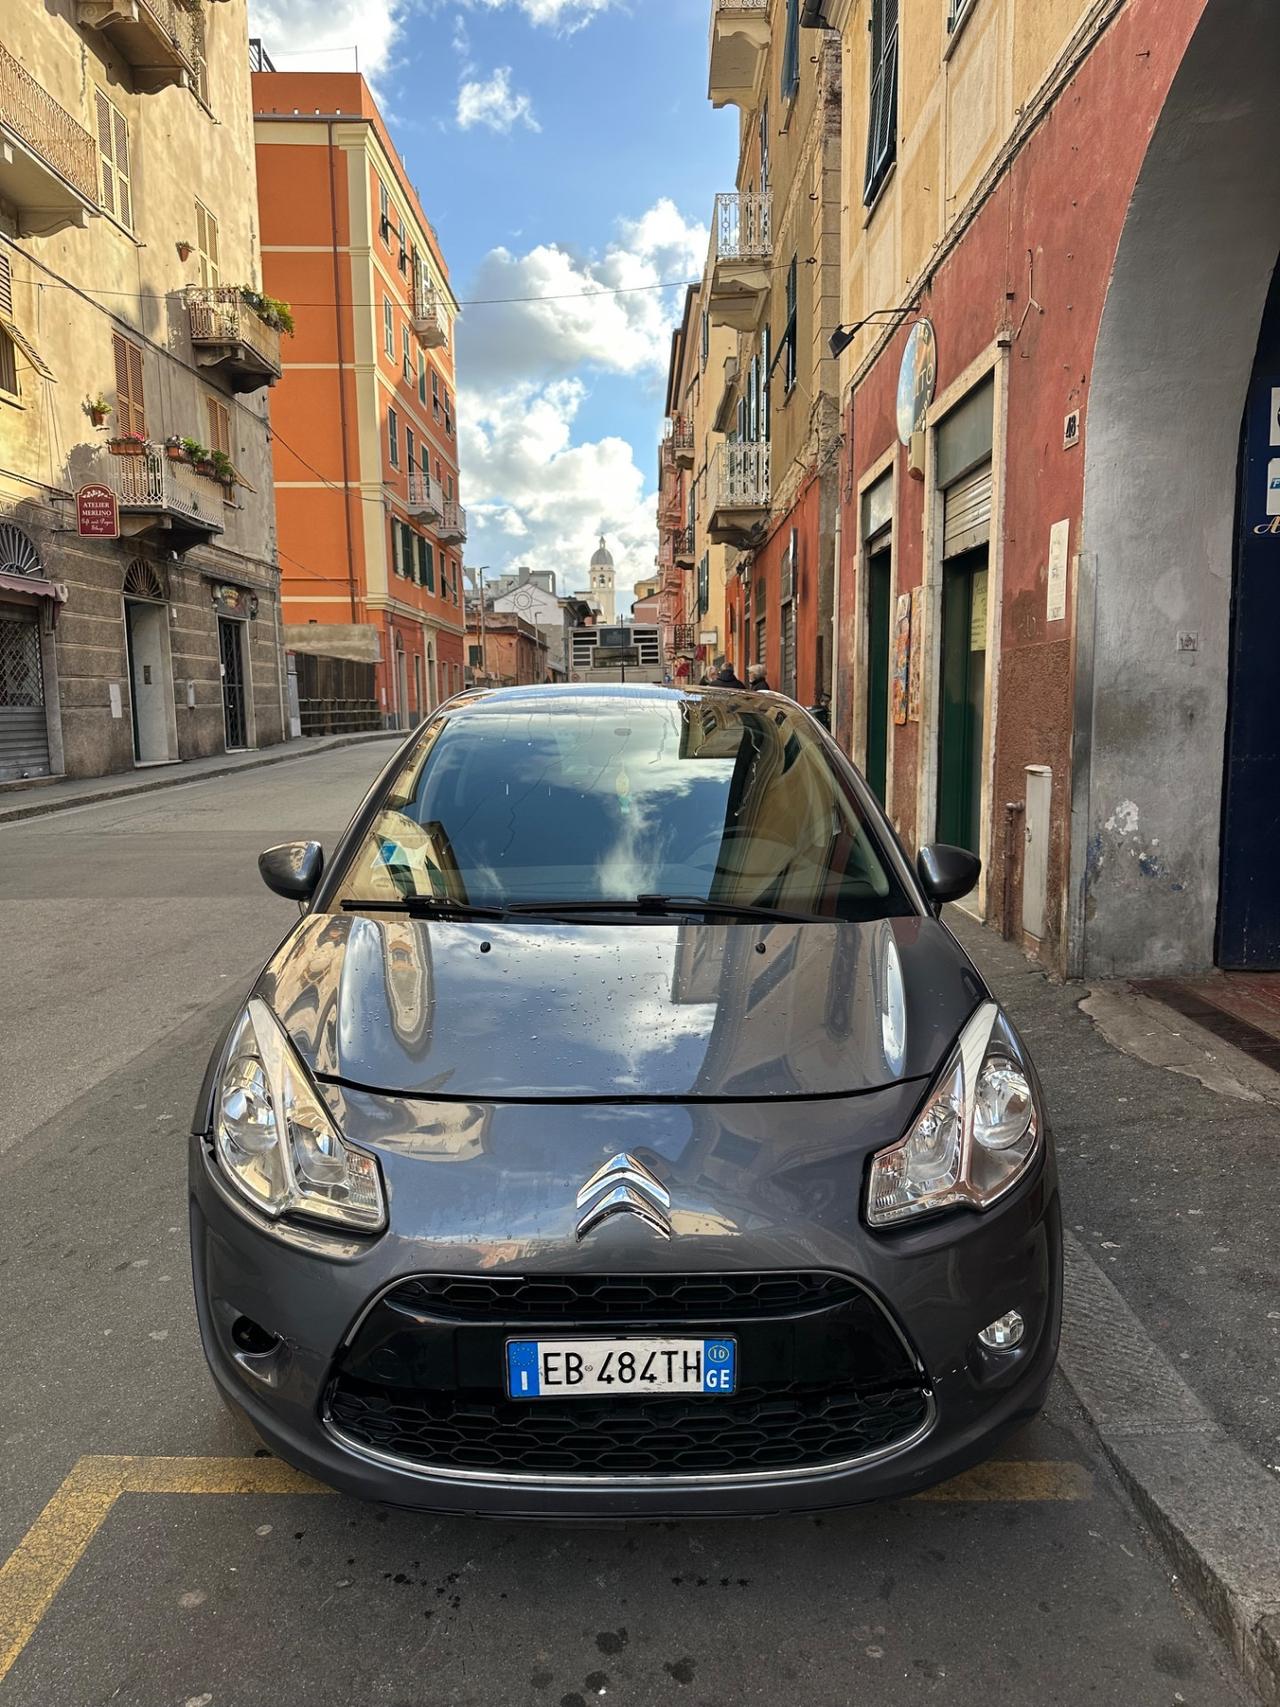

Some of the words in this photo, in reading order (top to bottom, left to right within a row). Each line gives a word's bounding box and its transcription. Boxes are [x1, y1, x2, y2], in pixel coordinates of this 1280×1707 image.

[712, 1349, 725, 1359] 10
[543, 1352, 584, 1385] EB
[597, 1350, 701, 1384] 484TH
[521, 1371, 528, 1391] I
[706, 1369, 730, 1388] GE
